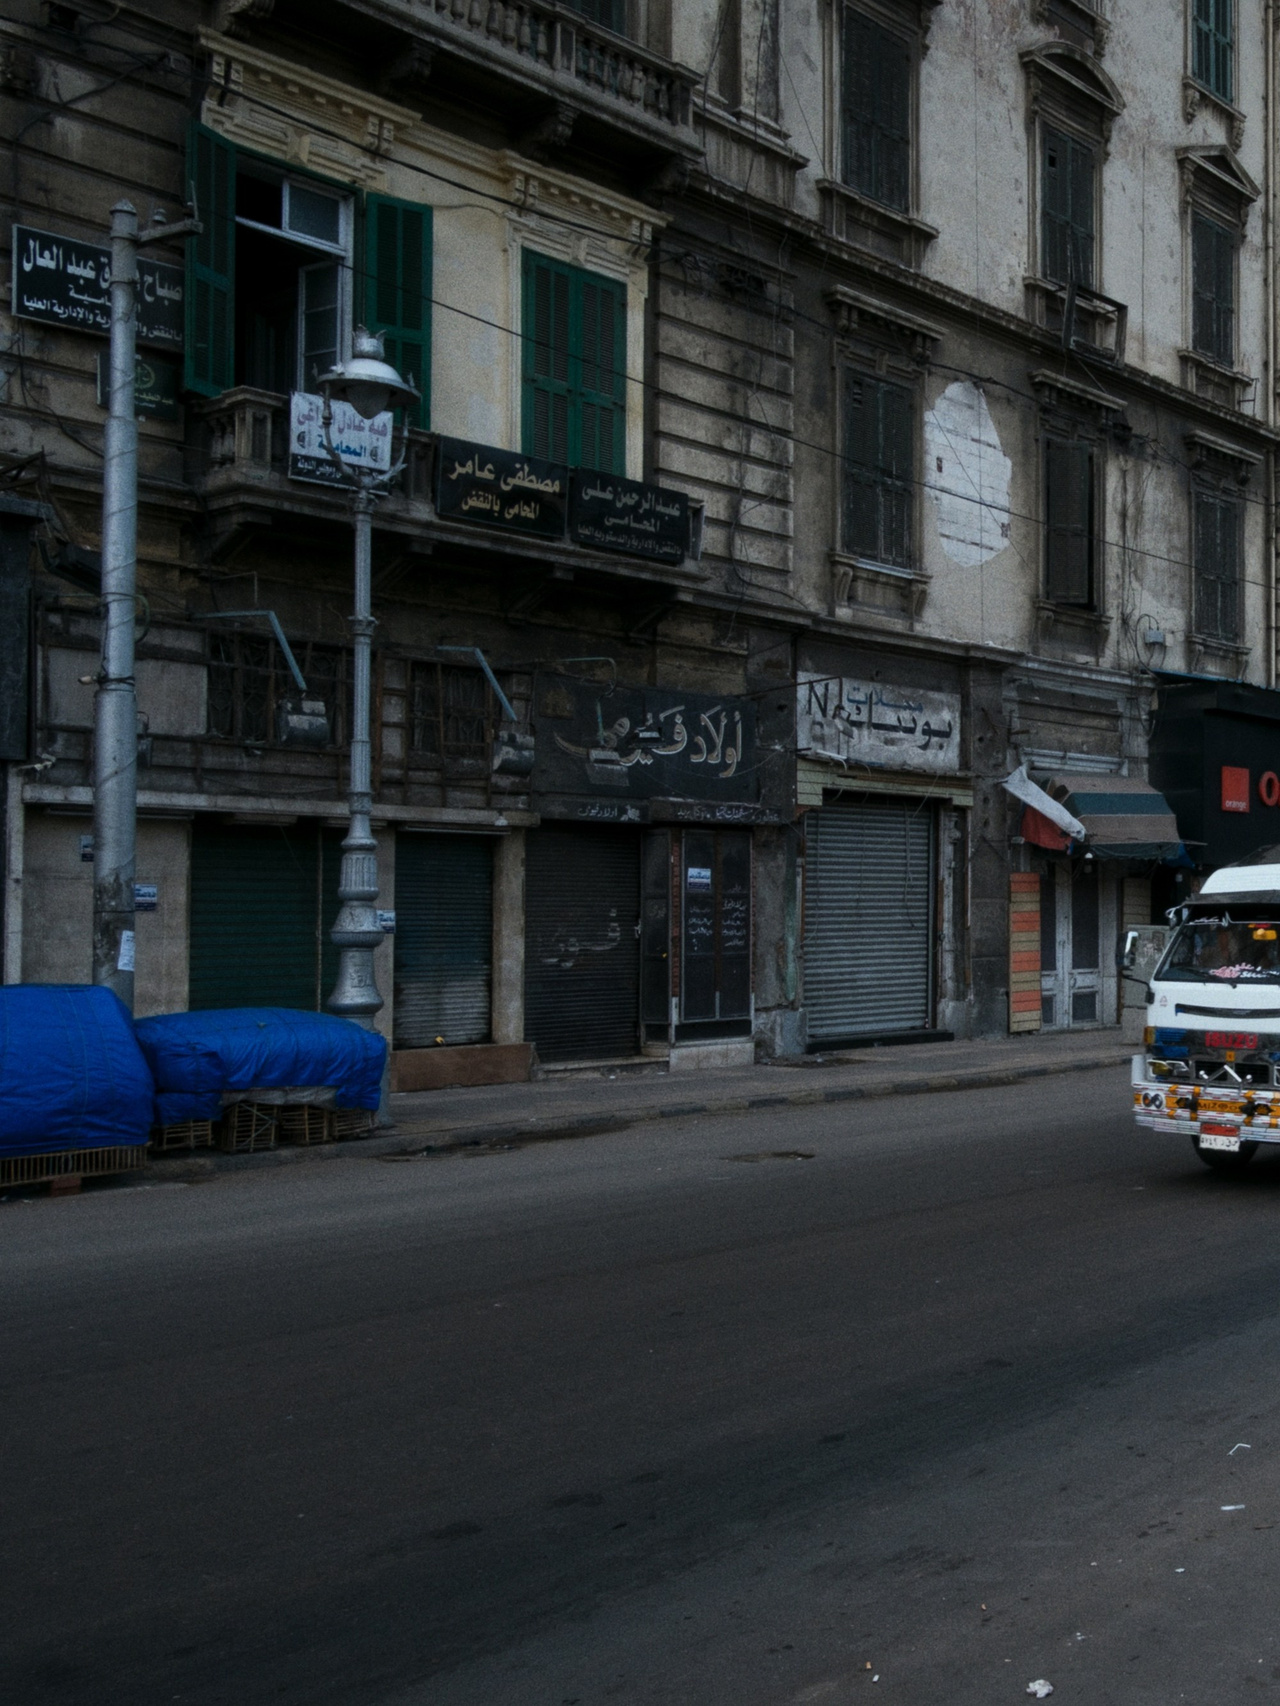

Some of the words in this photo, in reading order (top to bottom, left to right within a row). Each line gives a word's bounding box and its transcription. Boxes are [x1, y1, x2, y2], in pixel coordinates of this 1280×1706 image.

[22, 238, 64, 272] العال
[66, 252, 97, 285] عبد
[143, 270, 183, 306] صباح
[449, 453, 496, 480] عامر
[499, 462, 561, 494] مصطفى
[581, 480, 615, 501] على
[503, 501, 541, 521] المحامى
[604, 513, 661, 534] المحامى
[1225, 799, 1247, 811] orange
[1205, 1031, 1258, 1049] ISUZU
